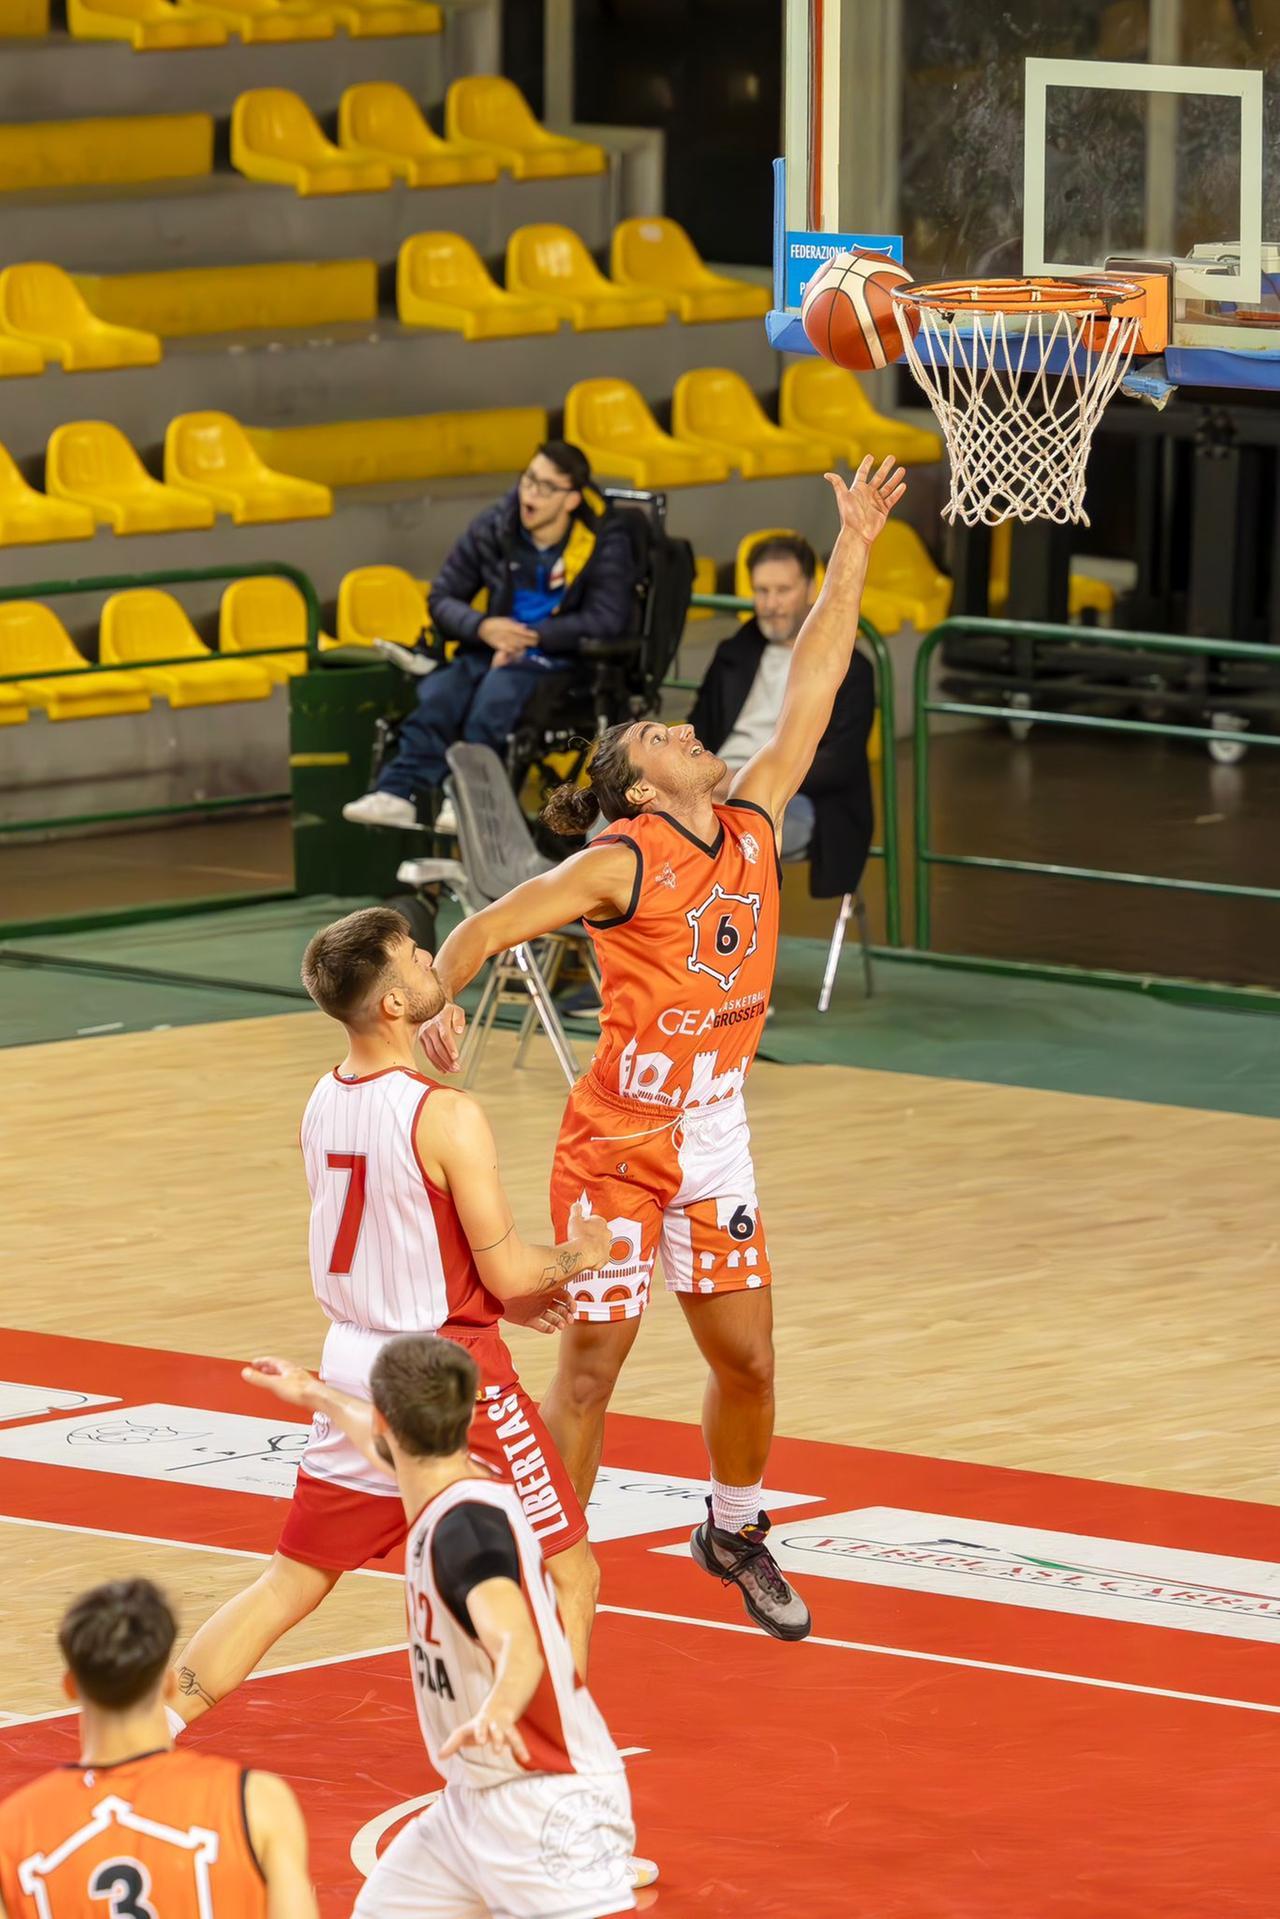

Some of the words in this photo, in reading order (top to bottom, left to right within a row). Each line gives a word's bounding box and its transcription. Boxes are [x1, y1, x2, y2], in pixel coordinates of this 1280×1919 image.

[715, 914, 740, 955] 6
[657, 1008, 716, 1036] GEA
[325, 1151, 368, 1276] 7
[728, 1204, 754, 1241] 6
[488, 1393, 569, 1540] LIBERTAS
[1099, 1581, 1280, 1611] CARRA
[90, 1857, 156, 1919] 3
